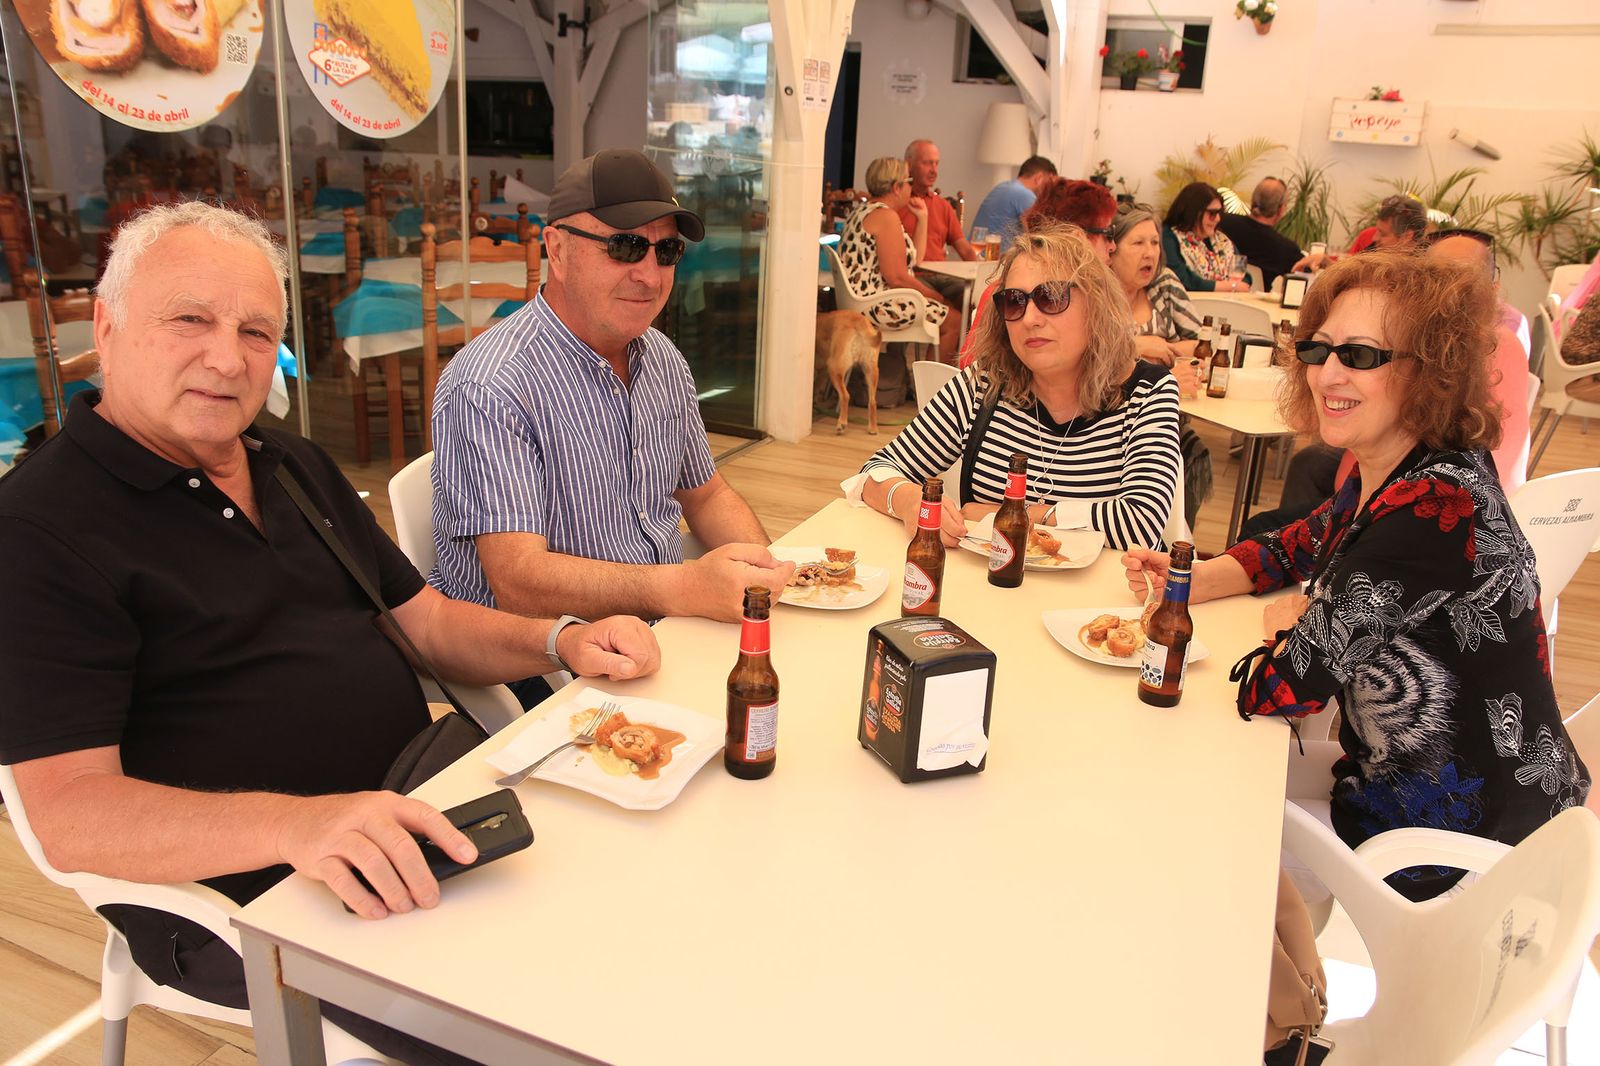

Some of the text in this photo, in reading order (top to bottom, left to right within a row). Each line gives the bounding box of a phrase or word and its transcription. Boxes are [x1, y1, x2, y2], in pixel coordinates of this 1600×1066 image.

[82, 80, 189, 122] del 14 al 23 de abril
[331, 99, 401, 130] del 14 al 23 de abril
[1529, 516, 1562, 526] CERVEZAS
